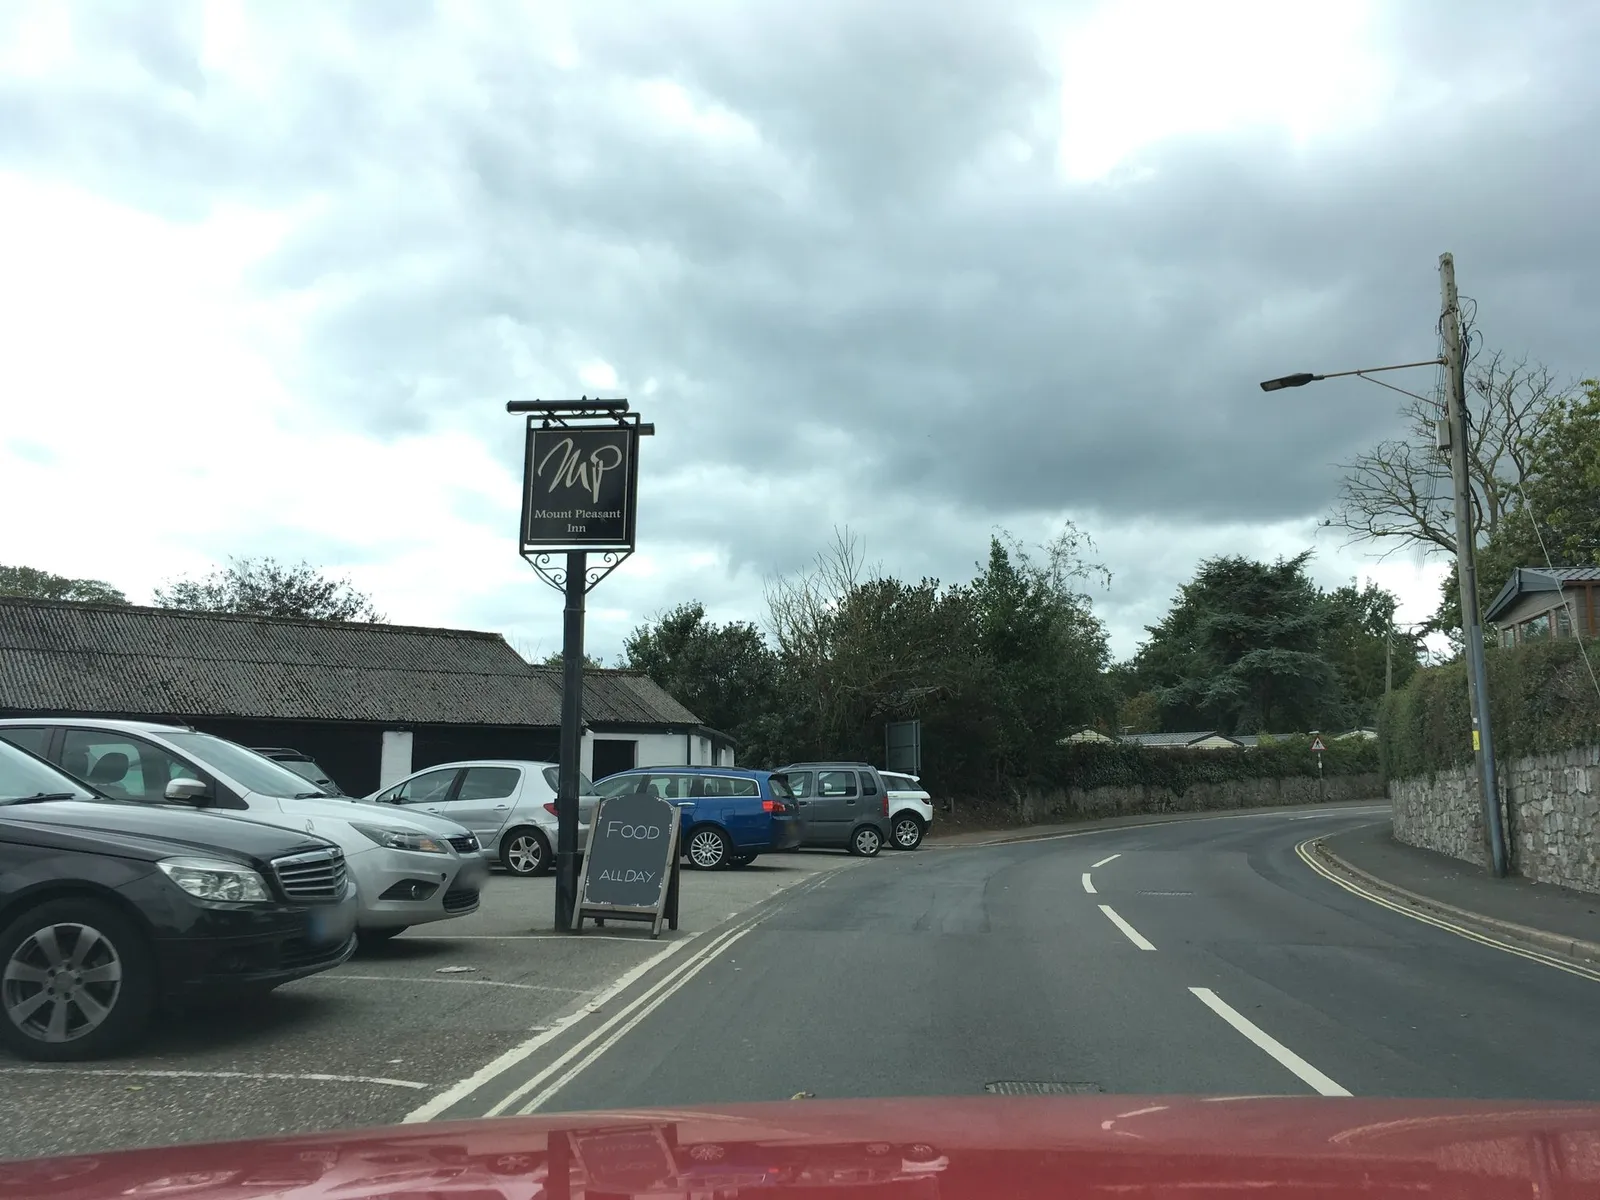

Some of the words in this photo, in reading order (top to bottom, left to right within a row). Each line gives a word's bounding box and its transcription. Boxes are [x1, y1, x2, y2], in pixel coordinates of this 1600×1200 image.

[534, 509, 572, 519] Mount
[575, 509, 621, 519] Pleasant
[567, 523, 586, 533] Inn
